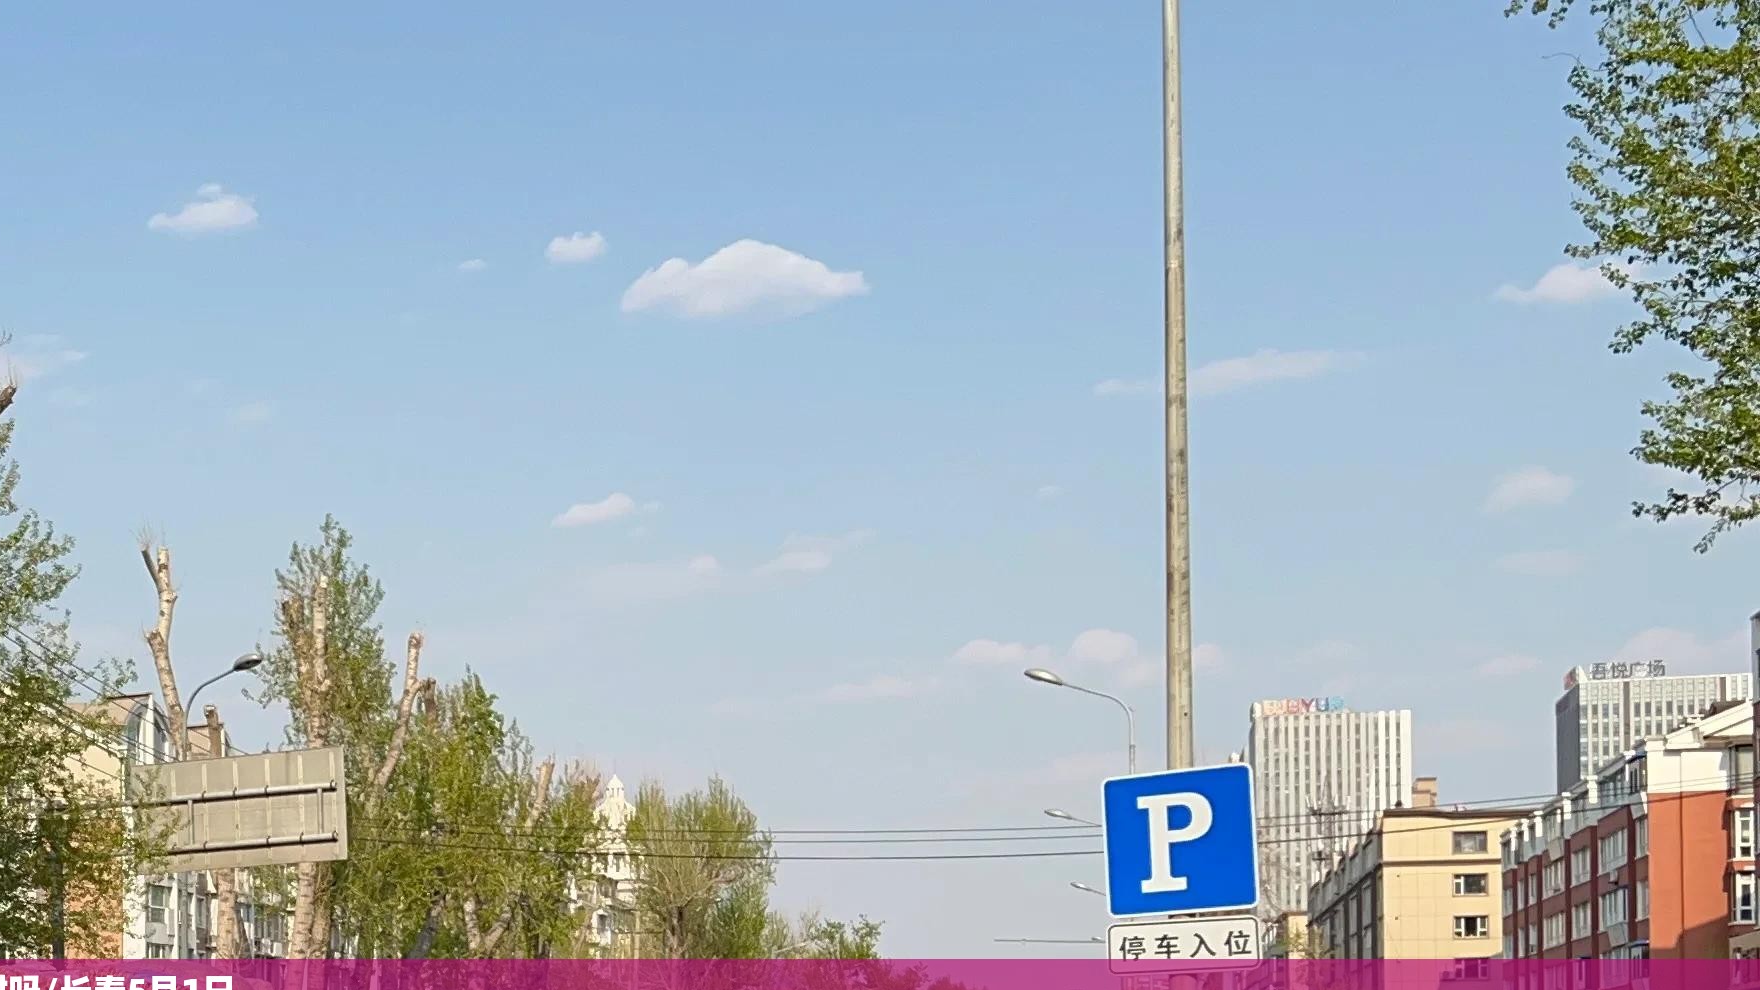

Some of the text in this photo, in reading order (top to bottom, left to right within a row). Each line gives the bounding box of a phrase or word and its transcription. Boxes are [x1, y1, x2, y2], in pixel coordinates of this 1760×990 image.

[1591, 660, 1665, 680] 吾悦广场
[1136, 792, 1213, 893] P
[1119, 931, 1252, 962] 停车入位
